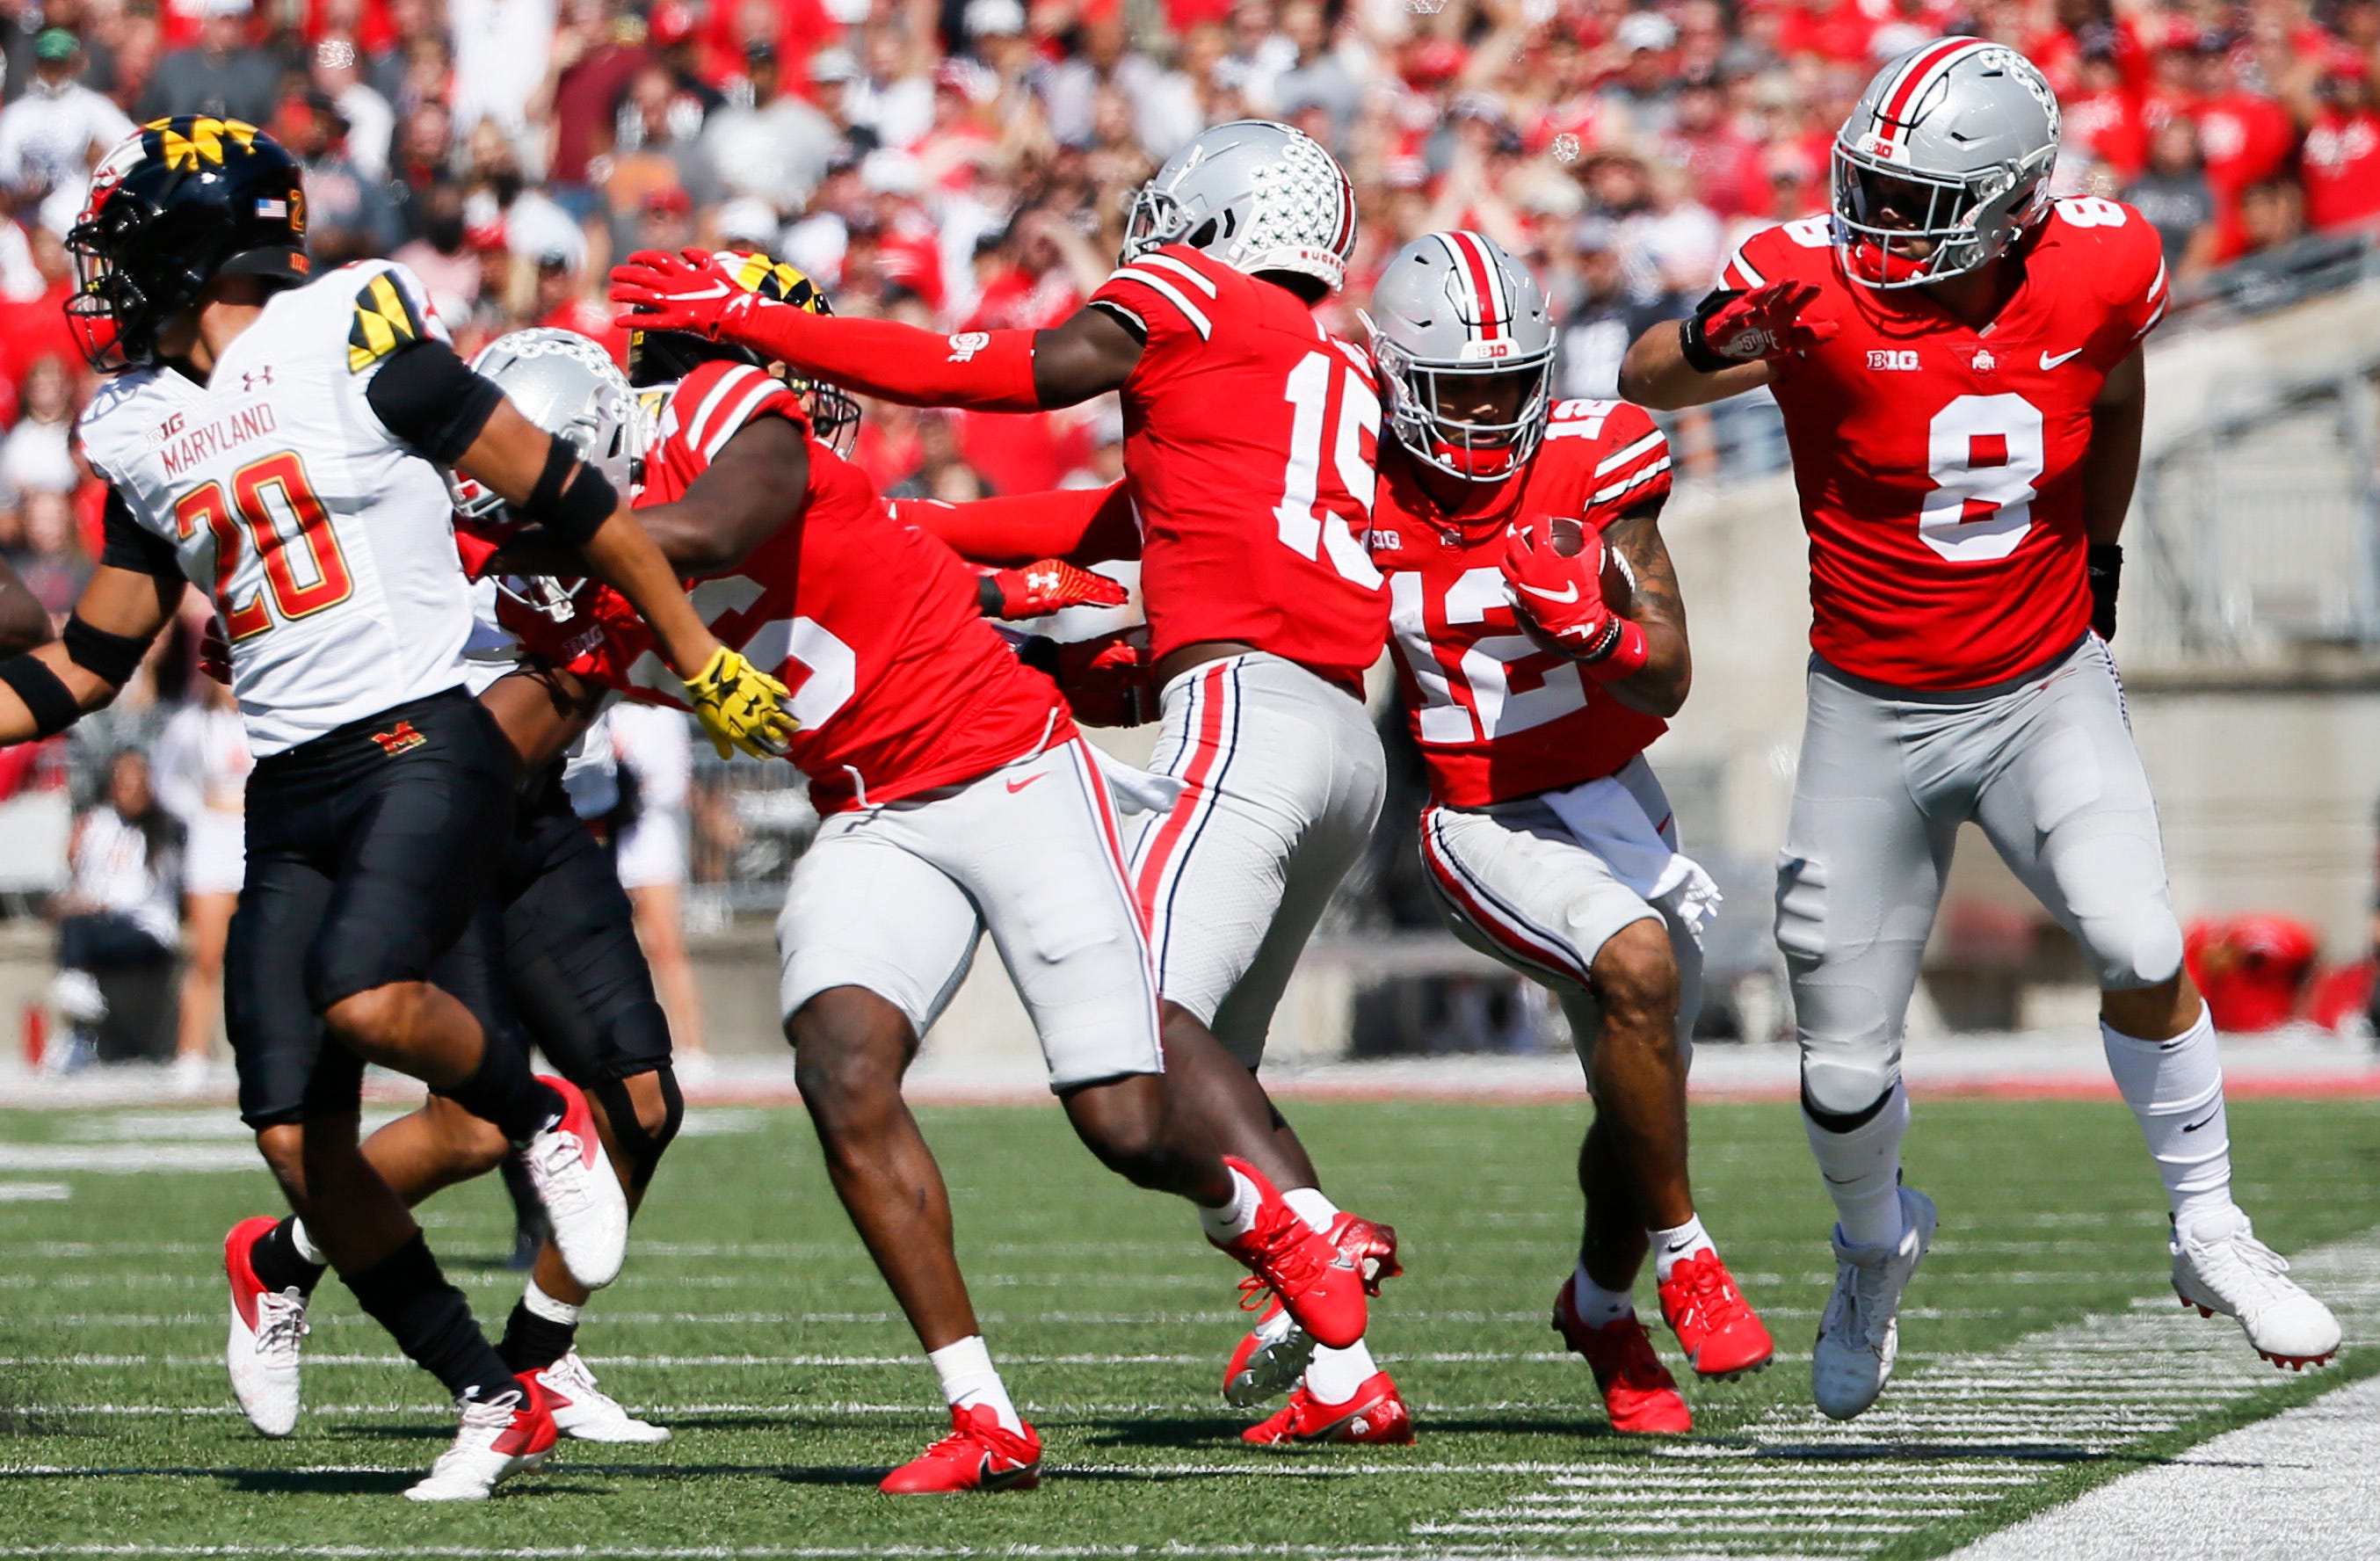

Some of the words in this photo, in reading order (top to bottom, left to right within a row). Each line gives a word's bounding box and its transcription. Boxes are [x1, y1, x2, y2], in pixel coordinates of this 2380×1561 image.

[161, 403, 277, 480] MARYLAND
[1918, 391, 2045, 563] 8
[175, 447, 355, 645] 20
[1388, 566, 1588, 744] 12
